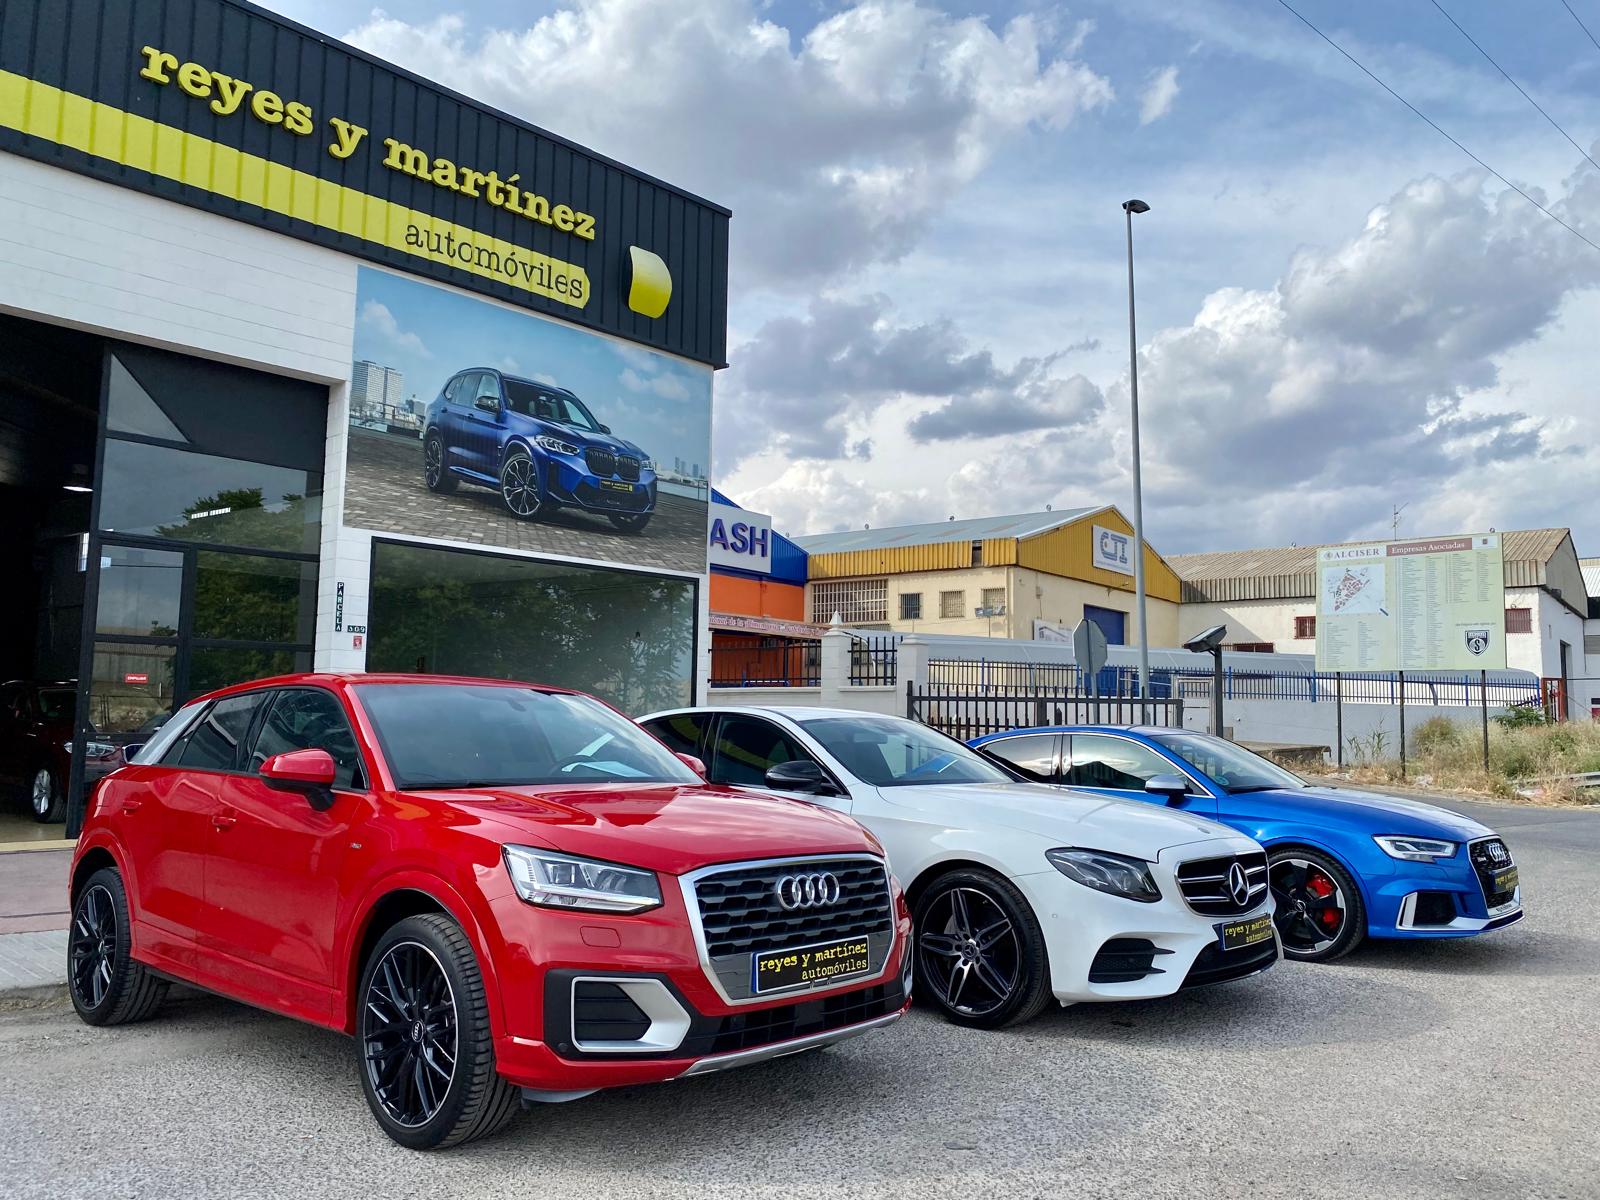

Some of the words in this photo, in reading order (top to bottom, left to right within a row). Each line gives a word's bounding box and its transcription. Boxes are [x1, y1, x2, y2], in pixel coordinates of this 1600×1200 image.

[140, 45, 313, 136] reyes
[328, 117, 369, 160] y
[382, 137, 596, 241] martínez
[405, 224, 584, 299] automóviles
[710, 518, 768, 557] ASH
[1391, 545, 1427, 555] Empresas
[1428, 541, 1465, 551] Asociadas
[1334, 548, 1380, 559] ALCISER
[336, 582, 344, 631] PARCELA
[1225, 926, 1244, 937] reyes
[1245, 925, 1250, 934] y
[760, 955, 798, 972] reyes
[802, 953, 811, 967] y
[815, 943, 867, 962] martínez
[802, 959, 867, 980] automóviles
